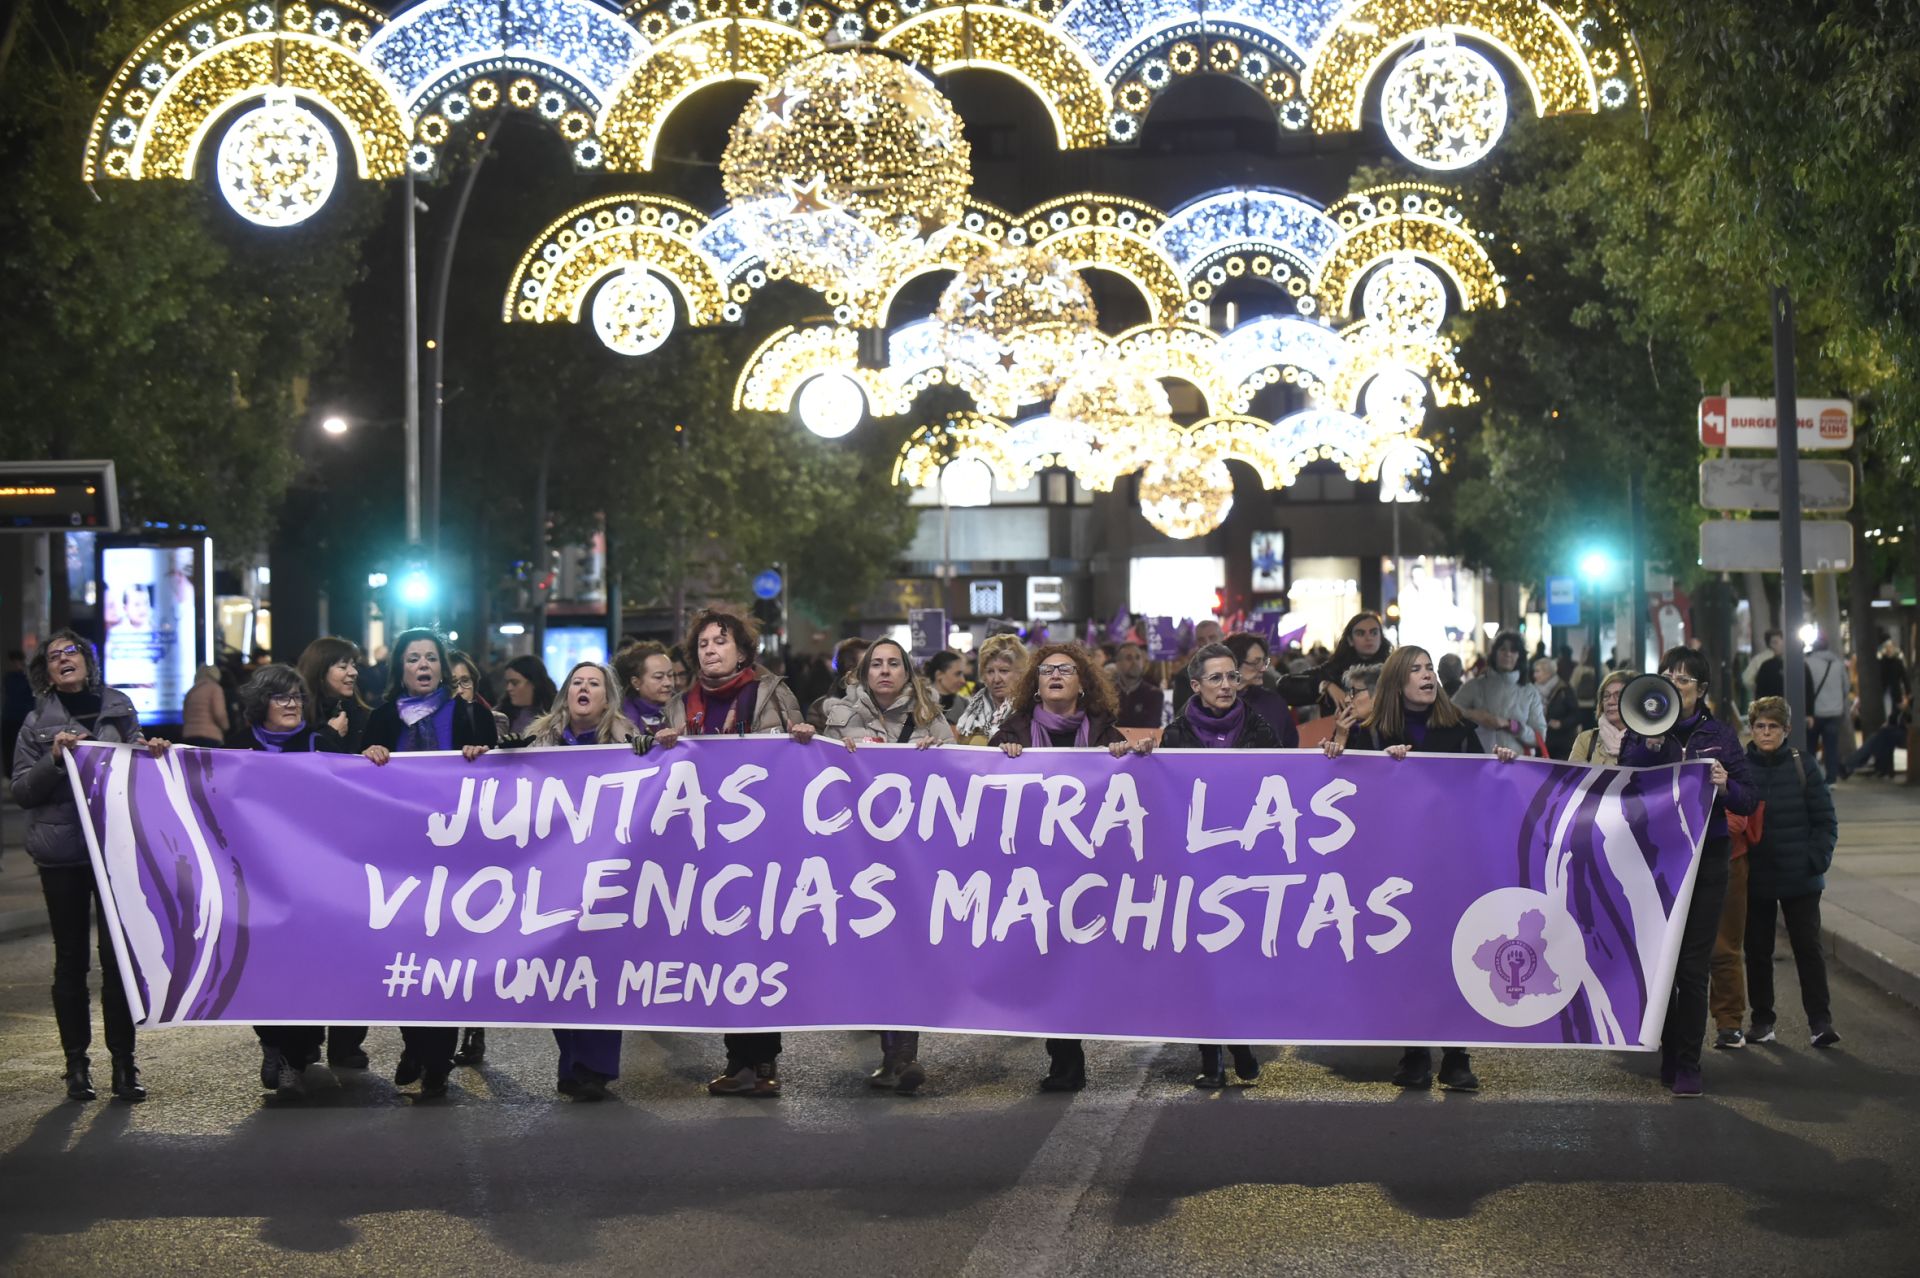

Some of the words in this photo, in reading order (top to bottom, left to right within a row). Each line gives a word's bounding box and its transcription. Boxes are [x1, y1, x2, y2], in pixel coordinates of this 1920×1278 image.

[1796, 418, 1814, 429] NG
[427, 761, 768, 850] JUNTAS
[802, 766, 1149, 862] CONTRA
[1186, 774, 1357, 864] LAS
[365, 856, 896, 945] VIOLENCIAS
[929, 866, 1413, 962] MACHISTAS
[383, 952, 477, 1001] #NI
[494, 956, 599, 1009] UNA
[617, 960, 789, 1007] MENOS
